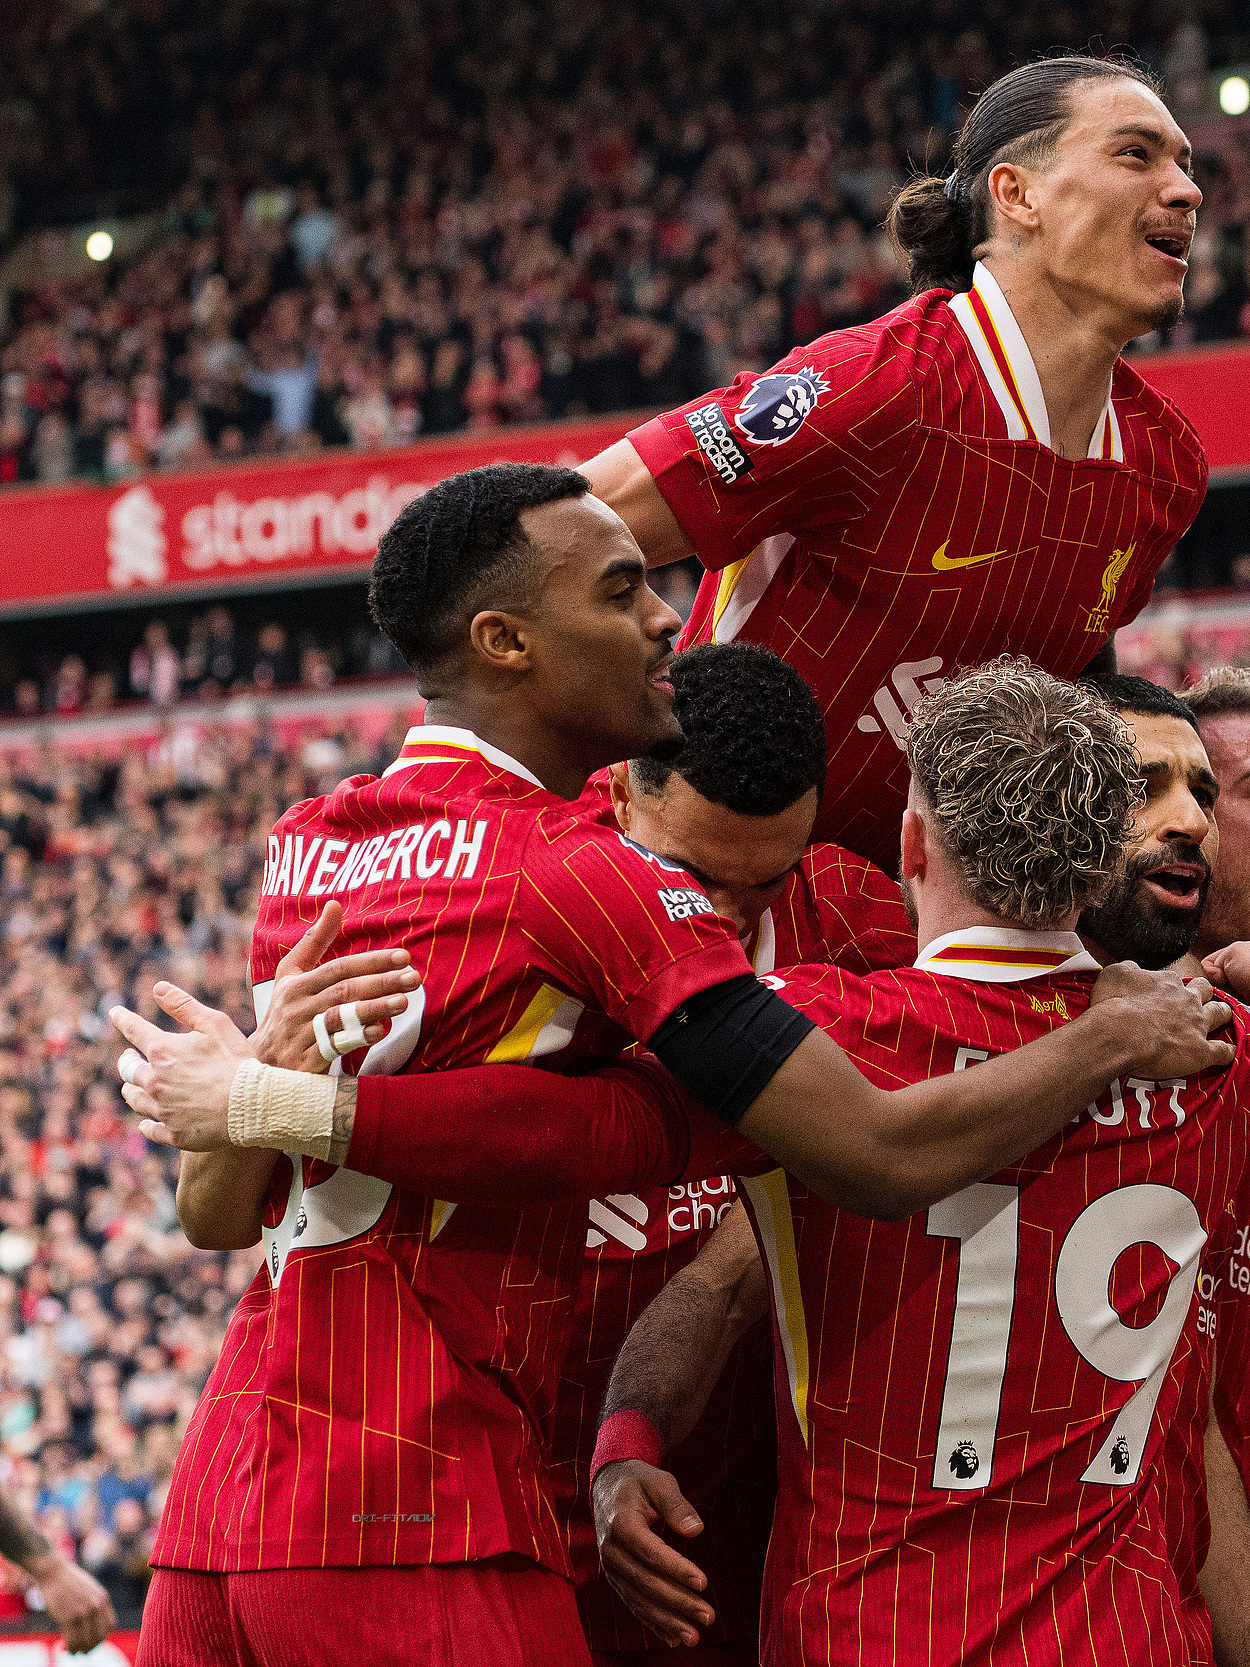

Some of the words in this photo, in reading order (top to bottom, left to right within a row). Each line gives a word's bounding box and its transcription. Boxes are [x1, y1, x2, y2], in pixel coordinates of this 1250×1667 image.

[703, 403, 719, 423] No
[695, 427, 737, 485] racism
[709, 422, 745, 469] room
[262, 818, 489, 896] RAVENBERCH
[657, 888, 687, 907] No
[666, 902, 694, 922] for
[1043, 1001, 1055, 1012] 97
[926, 1182, 1208, 1491] 19
